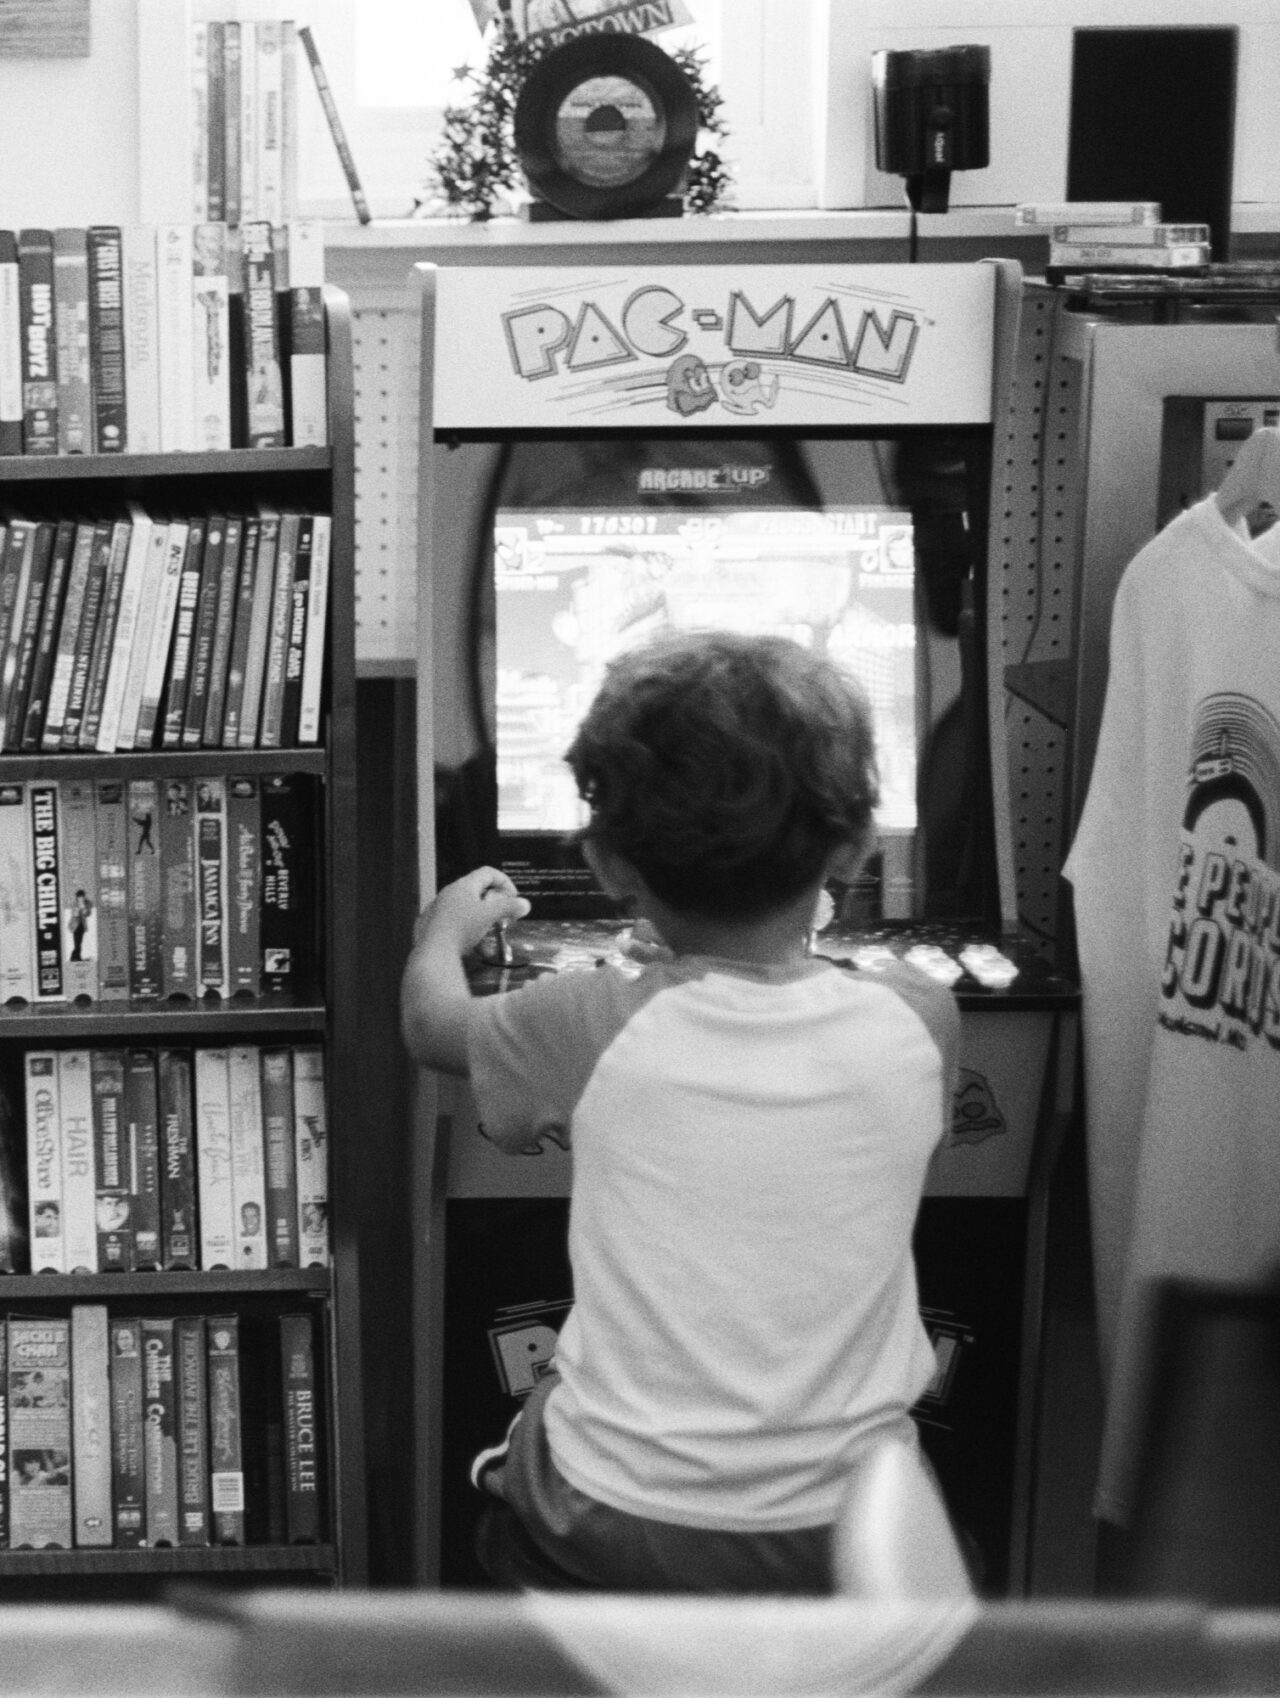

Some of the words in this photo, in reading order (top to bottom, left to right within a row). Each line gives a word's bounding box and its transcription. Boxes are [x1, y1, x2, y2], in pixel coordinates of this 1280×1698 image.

[31, 284, 53, 327] HOT
[27, 325, 49, 377] BOYZ
[500, 283, 928, 384] PAC-MAN
[197, 636, 210, 660] LIVE
[34, 791, 55, 832] THE
[35, 835, 56, 871] BIG
[36, 872, 58, 930] CHILL
[199, 859, 221, 919] JAMAICA
[264, 875, 277, 904] HILLS
[276, 868, 290, 910] BEVERLY
[134, 925, 147, 972] DEATH
[200, 919, 222, 946] INN
[67, 1115, 89, 1178] HAIR
[166, 1113, 181, 1179] FRESHMAN
[145, 1338, 163, 1398] CHINESE
[160, 1354, 172, 1382] THE
[183, 1429, 201, 1454] LEE
[296, 1389, 314, 1453] BRUCE
[183, 1458, 201, 1504] BRUCE
[299, 1459, 316, 1492] LEE
